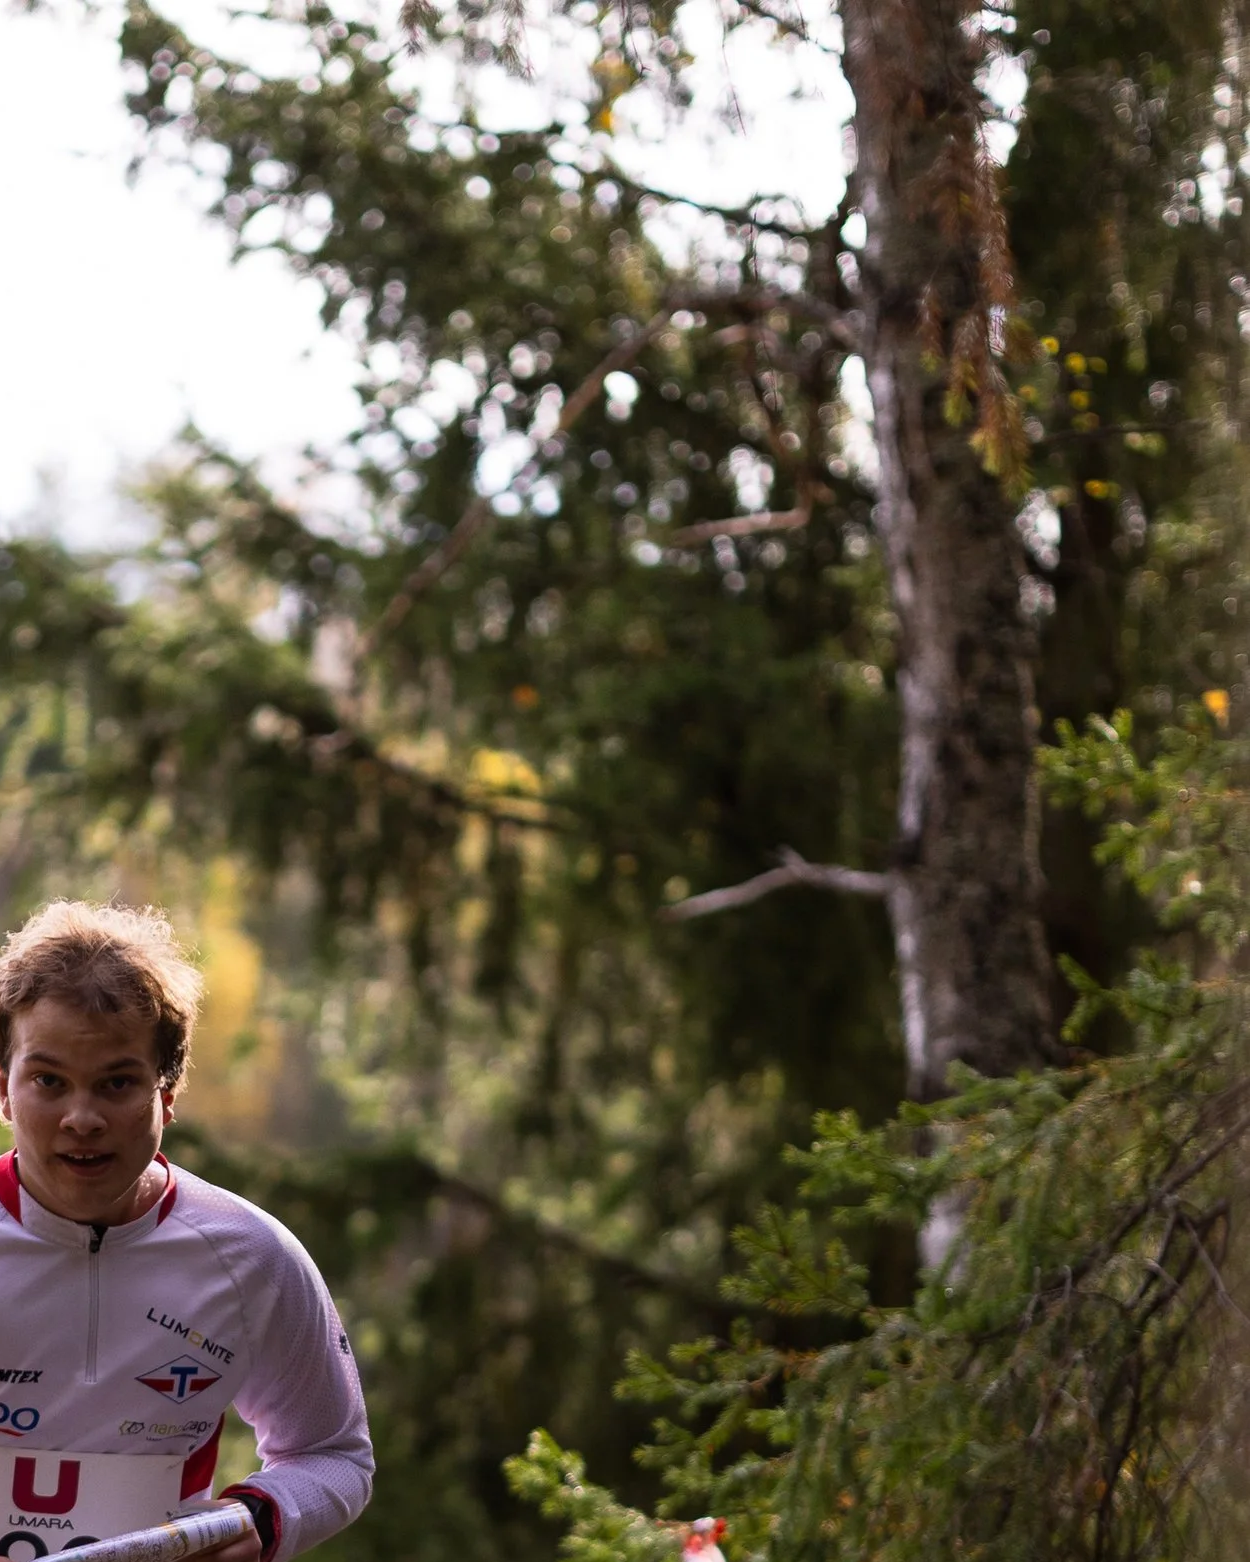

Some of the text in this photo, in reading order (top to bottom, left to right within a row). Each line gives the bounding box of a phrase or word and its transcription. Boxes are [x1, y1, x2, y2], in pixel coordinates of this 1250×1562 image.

[147, 1307, 235, 1364] LUMONITE
[171, 1366, 198, 1398] T
[12, 1456, 81, 1515] U
[9, 1514, 74, 1530] UMARA
